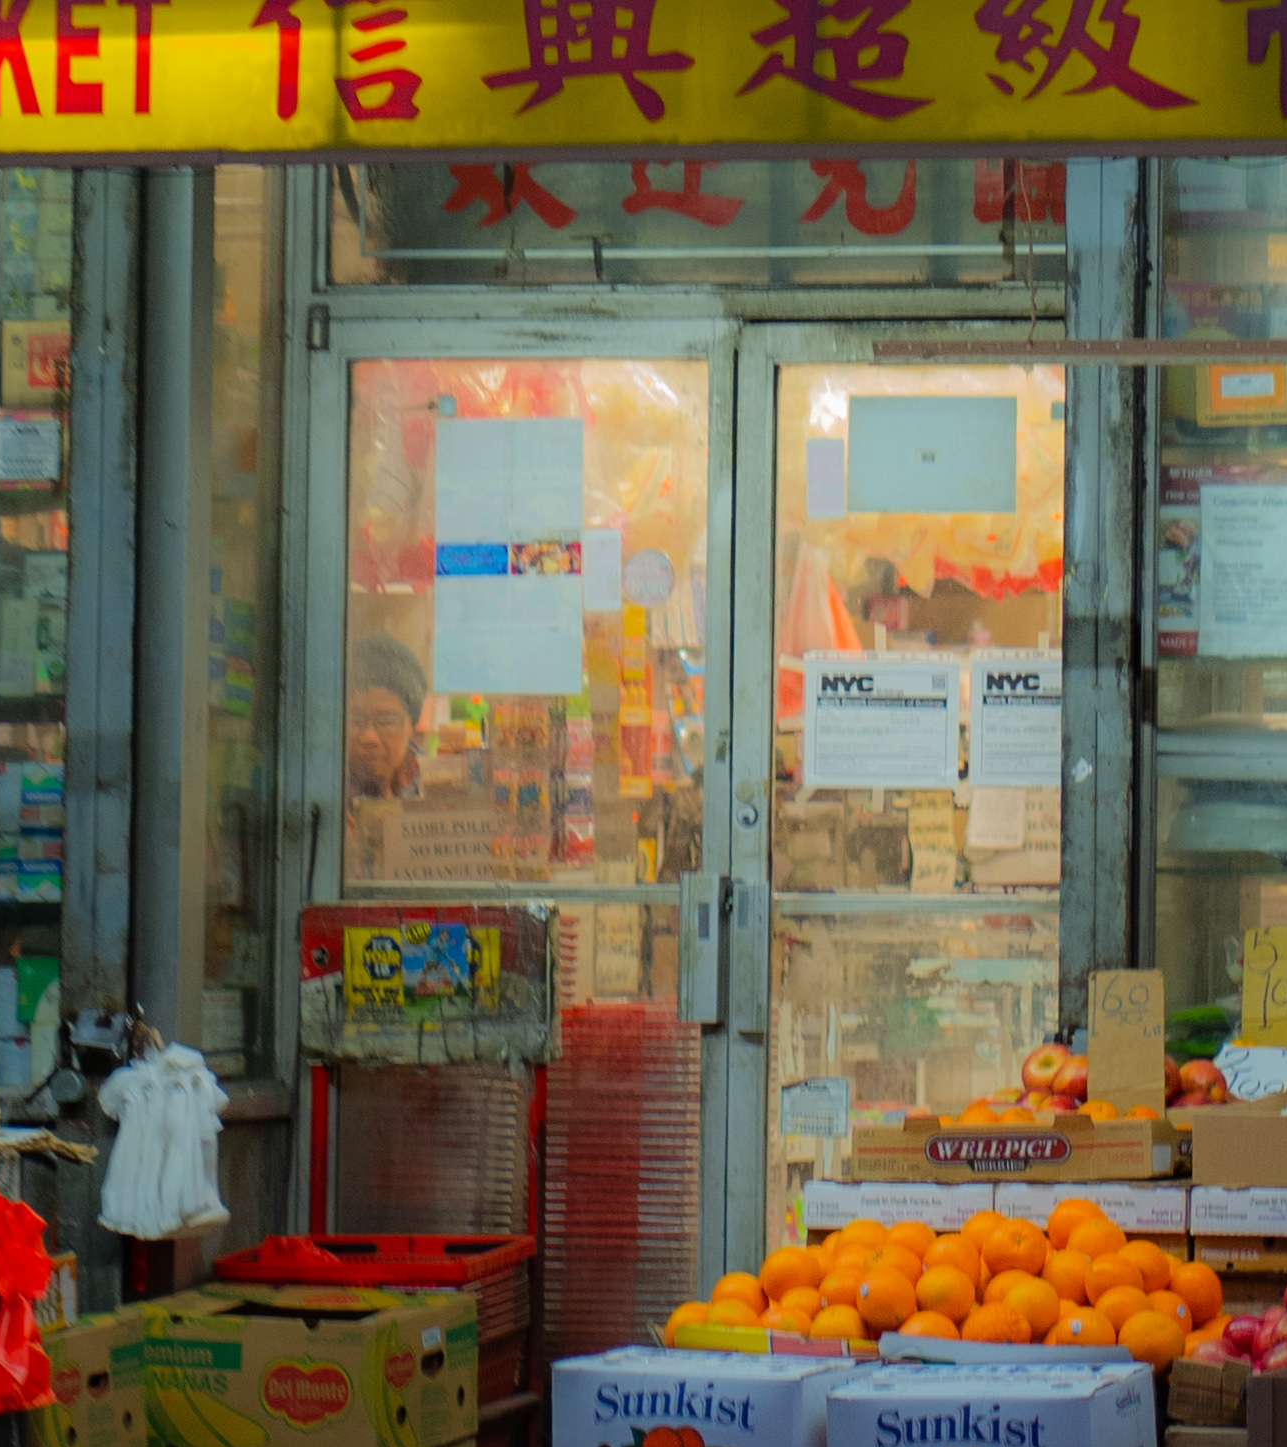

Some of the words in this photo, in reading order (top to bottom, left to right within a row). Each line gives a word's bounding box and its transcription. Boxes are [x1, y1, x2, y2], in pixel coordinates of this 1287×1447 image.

[821, 676, 874, 692] NYC
[986, 674, 1040, 691] NYC
[594, 1380, 754, 1432] Sunkist
